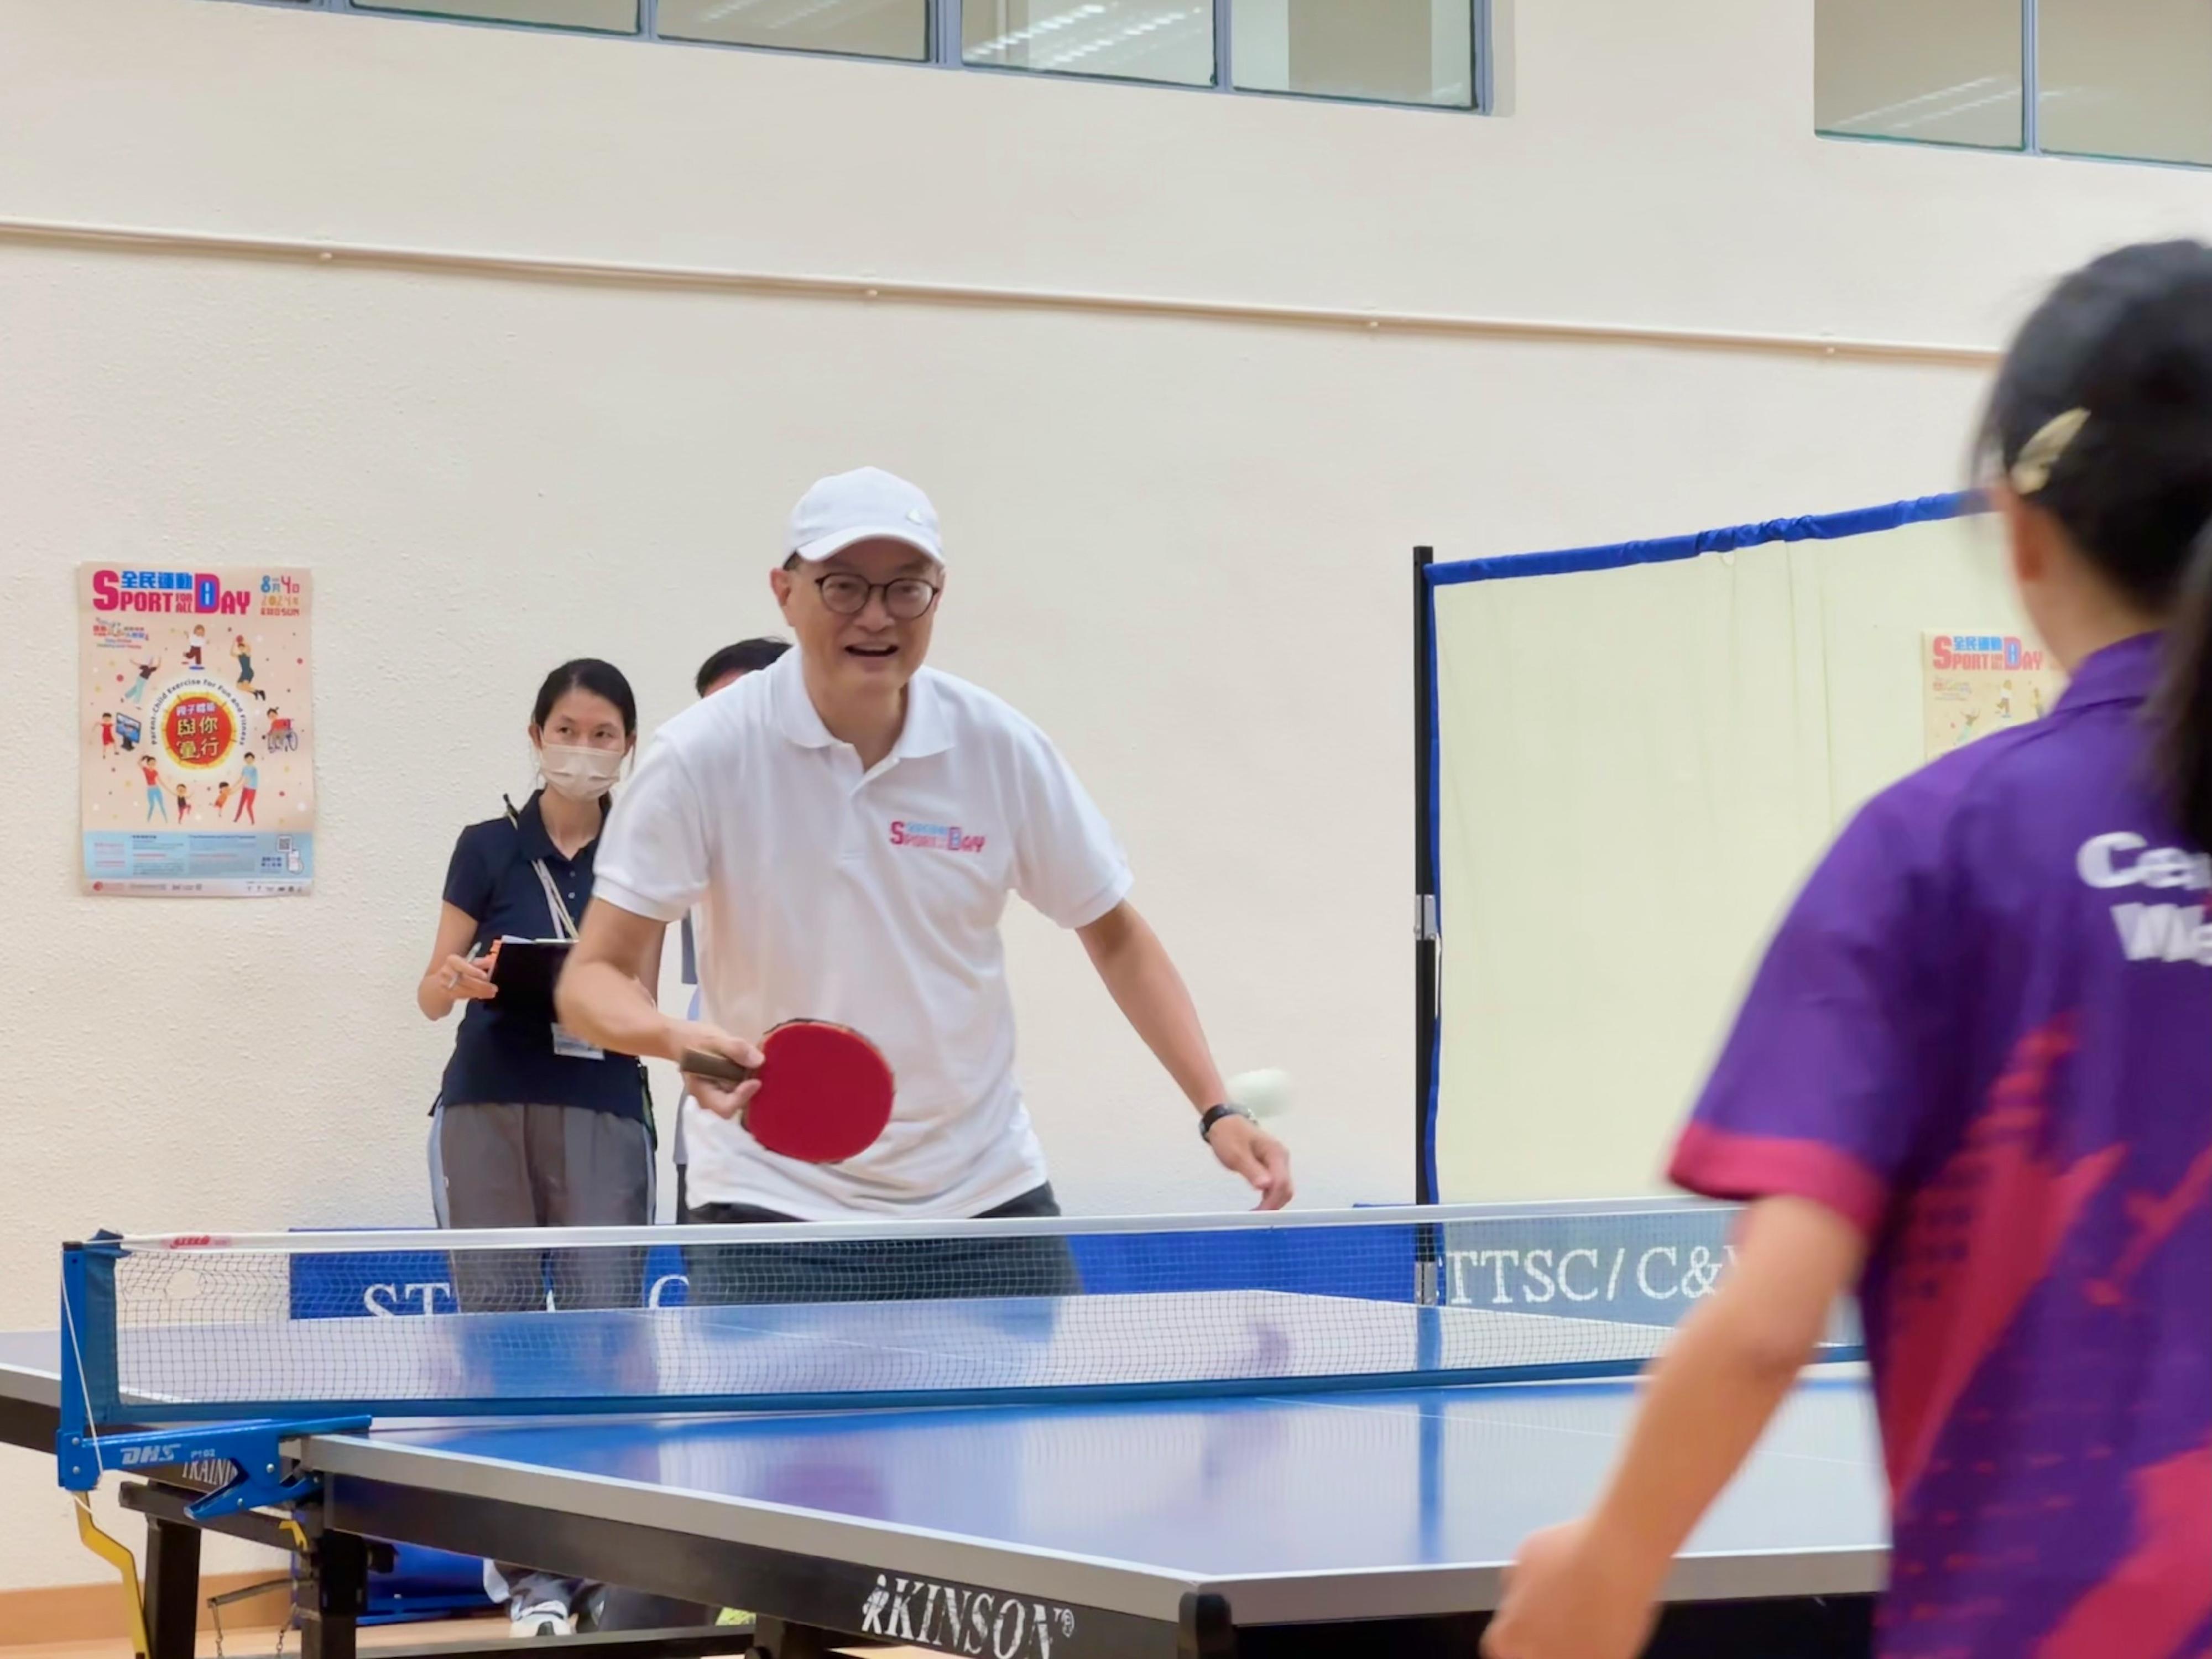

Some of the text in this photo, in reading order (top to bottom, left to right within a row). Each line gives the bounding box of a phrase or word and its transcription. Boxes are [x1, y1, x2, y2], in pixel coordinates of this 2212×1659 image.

[93, 570, 173, 613] SPORT
[195, 573, 251, 614] DAY
[1933, 636, 1989, 670] SPORT
[167, 679, 201, 694] Exercise
[204, 679, 216, 687] for
[120, 1443, 181, 1465] DHS
